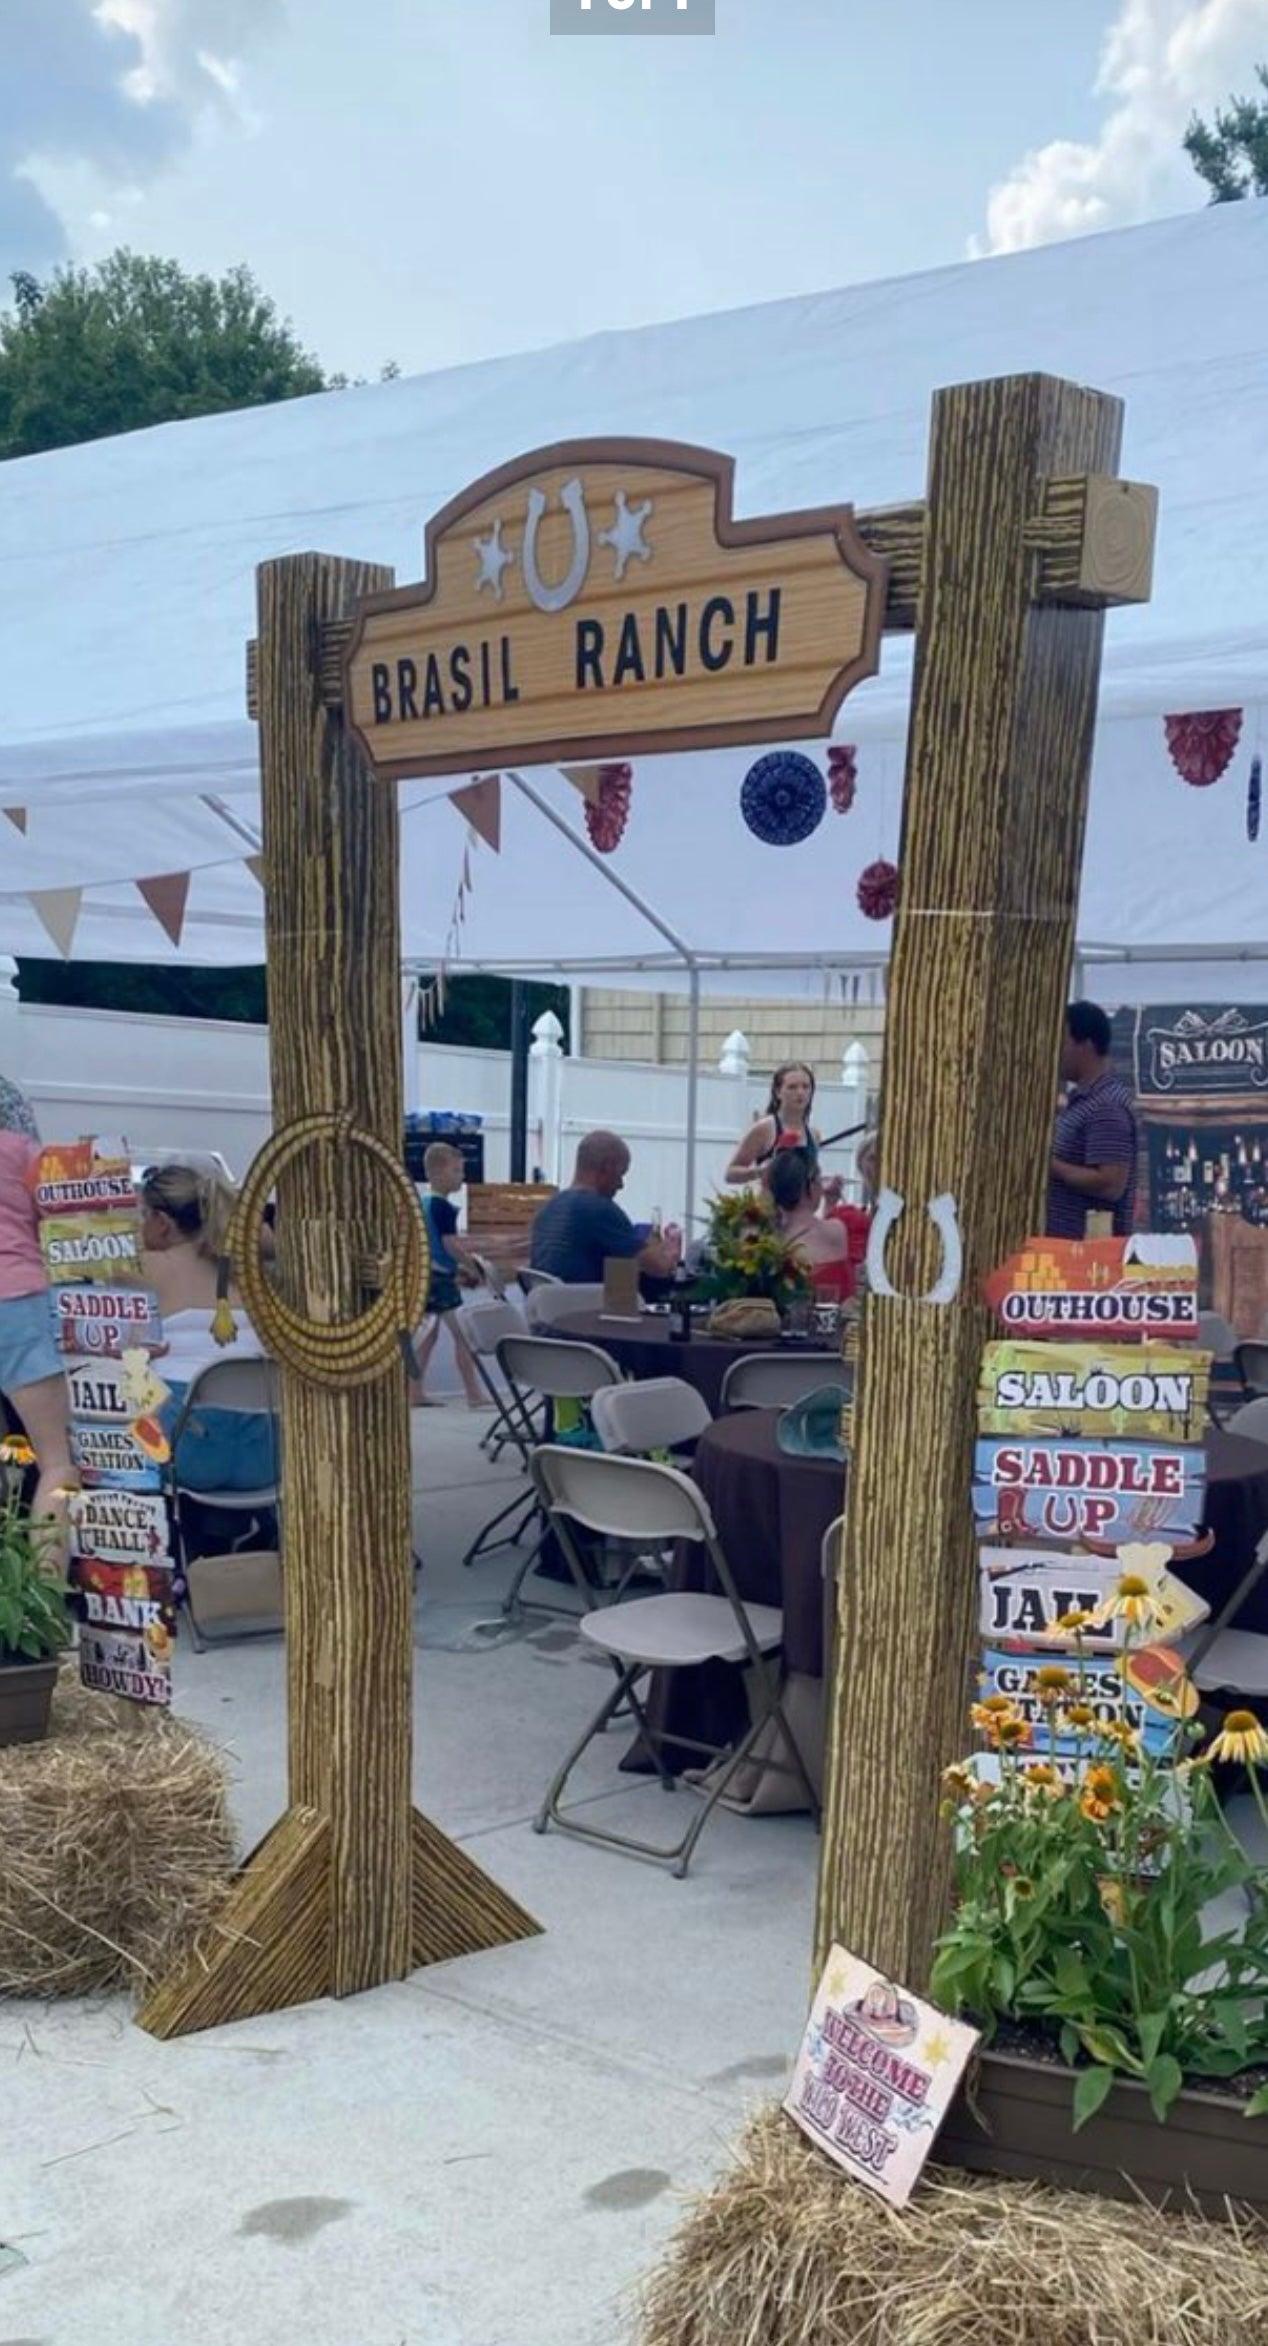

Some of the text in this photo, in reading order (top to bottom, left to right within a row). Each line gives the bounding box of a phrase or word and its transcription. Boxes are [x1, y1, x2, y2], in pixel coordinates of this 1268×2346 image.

[372, 587, 782, 725] BRASIL RANCH
[1159, 1038, 1265, 1069] SALOON
[38, 1177, 133, 1204] OUTHOUSE
[49, 1234, 137, 1264] SALOON
[59, 1292, 148, 1320] SADDLE
[1005, 1293, 1194, 1323] OUTHOUSE
[85, 1322, 119, 1348] UP
[71, 1379, 127, 1413] JAIL
[996, 1370, 1192, 1412] SALOON
[78, 1432, 134, 1451] GAMES
[81, 1451, 144, 1471] STATION
[994, 1449, 1181, 1494] SADDLE
[86, 1503, 148, 1529] DANCE
[1045, 1495, 1115, 1534] UP
[93, 1528, 146, 1552] HALL
[86, 1590, 160, 1628] BANK
[823, 2007, 932, 2102] WELCOME
[847, 2068, 893, 2120] THE
[836, 2102, 898, 2170] WEST
